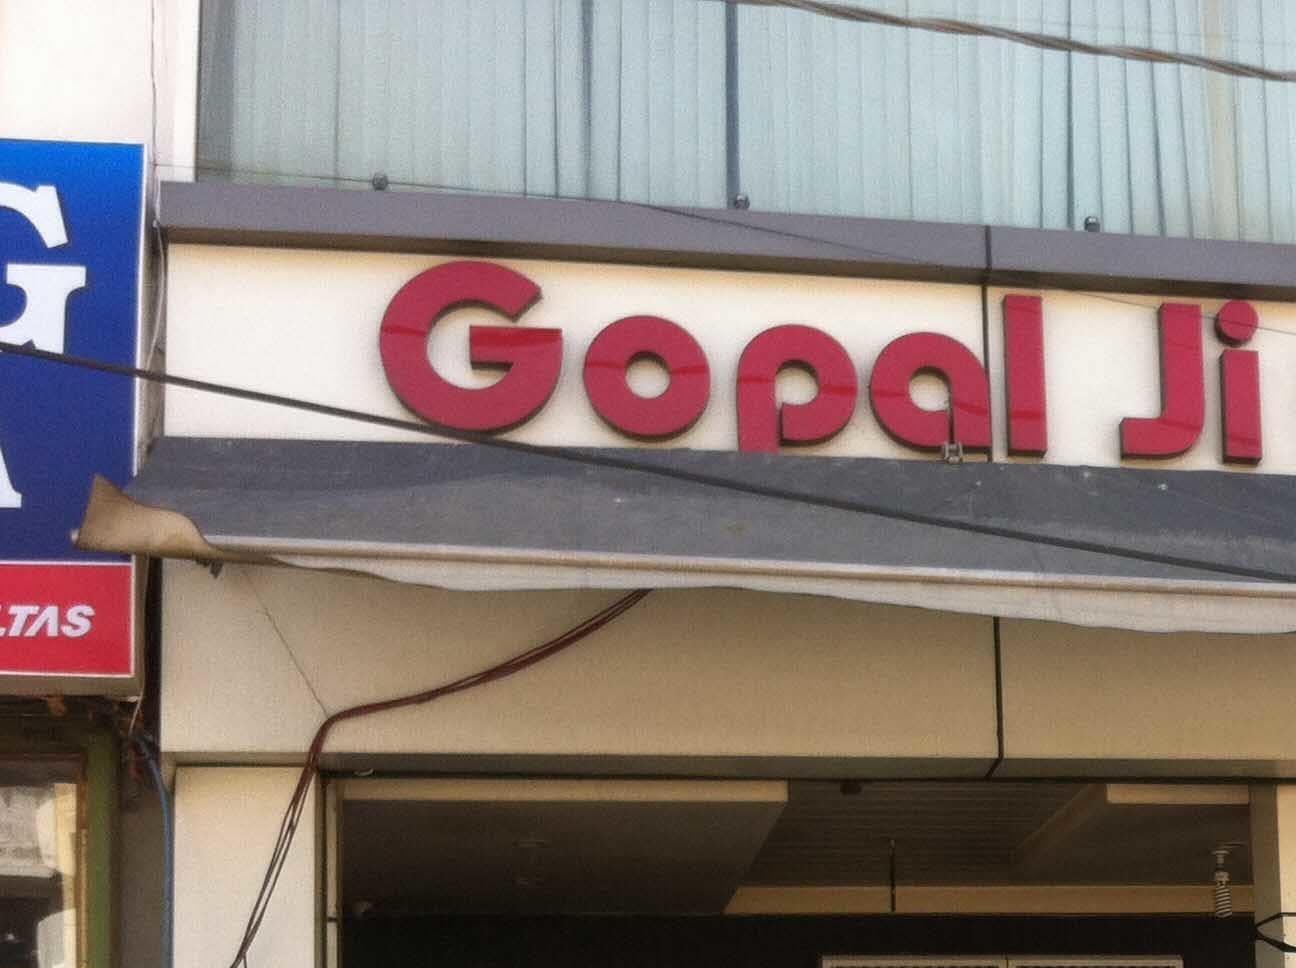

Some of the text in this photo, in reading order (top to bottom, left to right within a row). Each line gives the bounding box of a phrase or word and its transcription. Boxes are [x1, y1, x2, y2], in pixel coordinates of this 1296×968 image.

[379, 260, 1048, 457] Gopal
[1119, 299, 1262, 465] Ji
[0, 604, 95, 638] TAS
